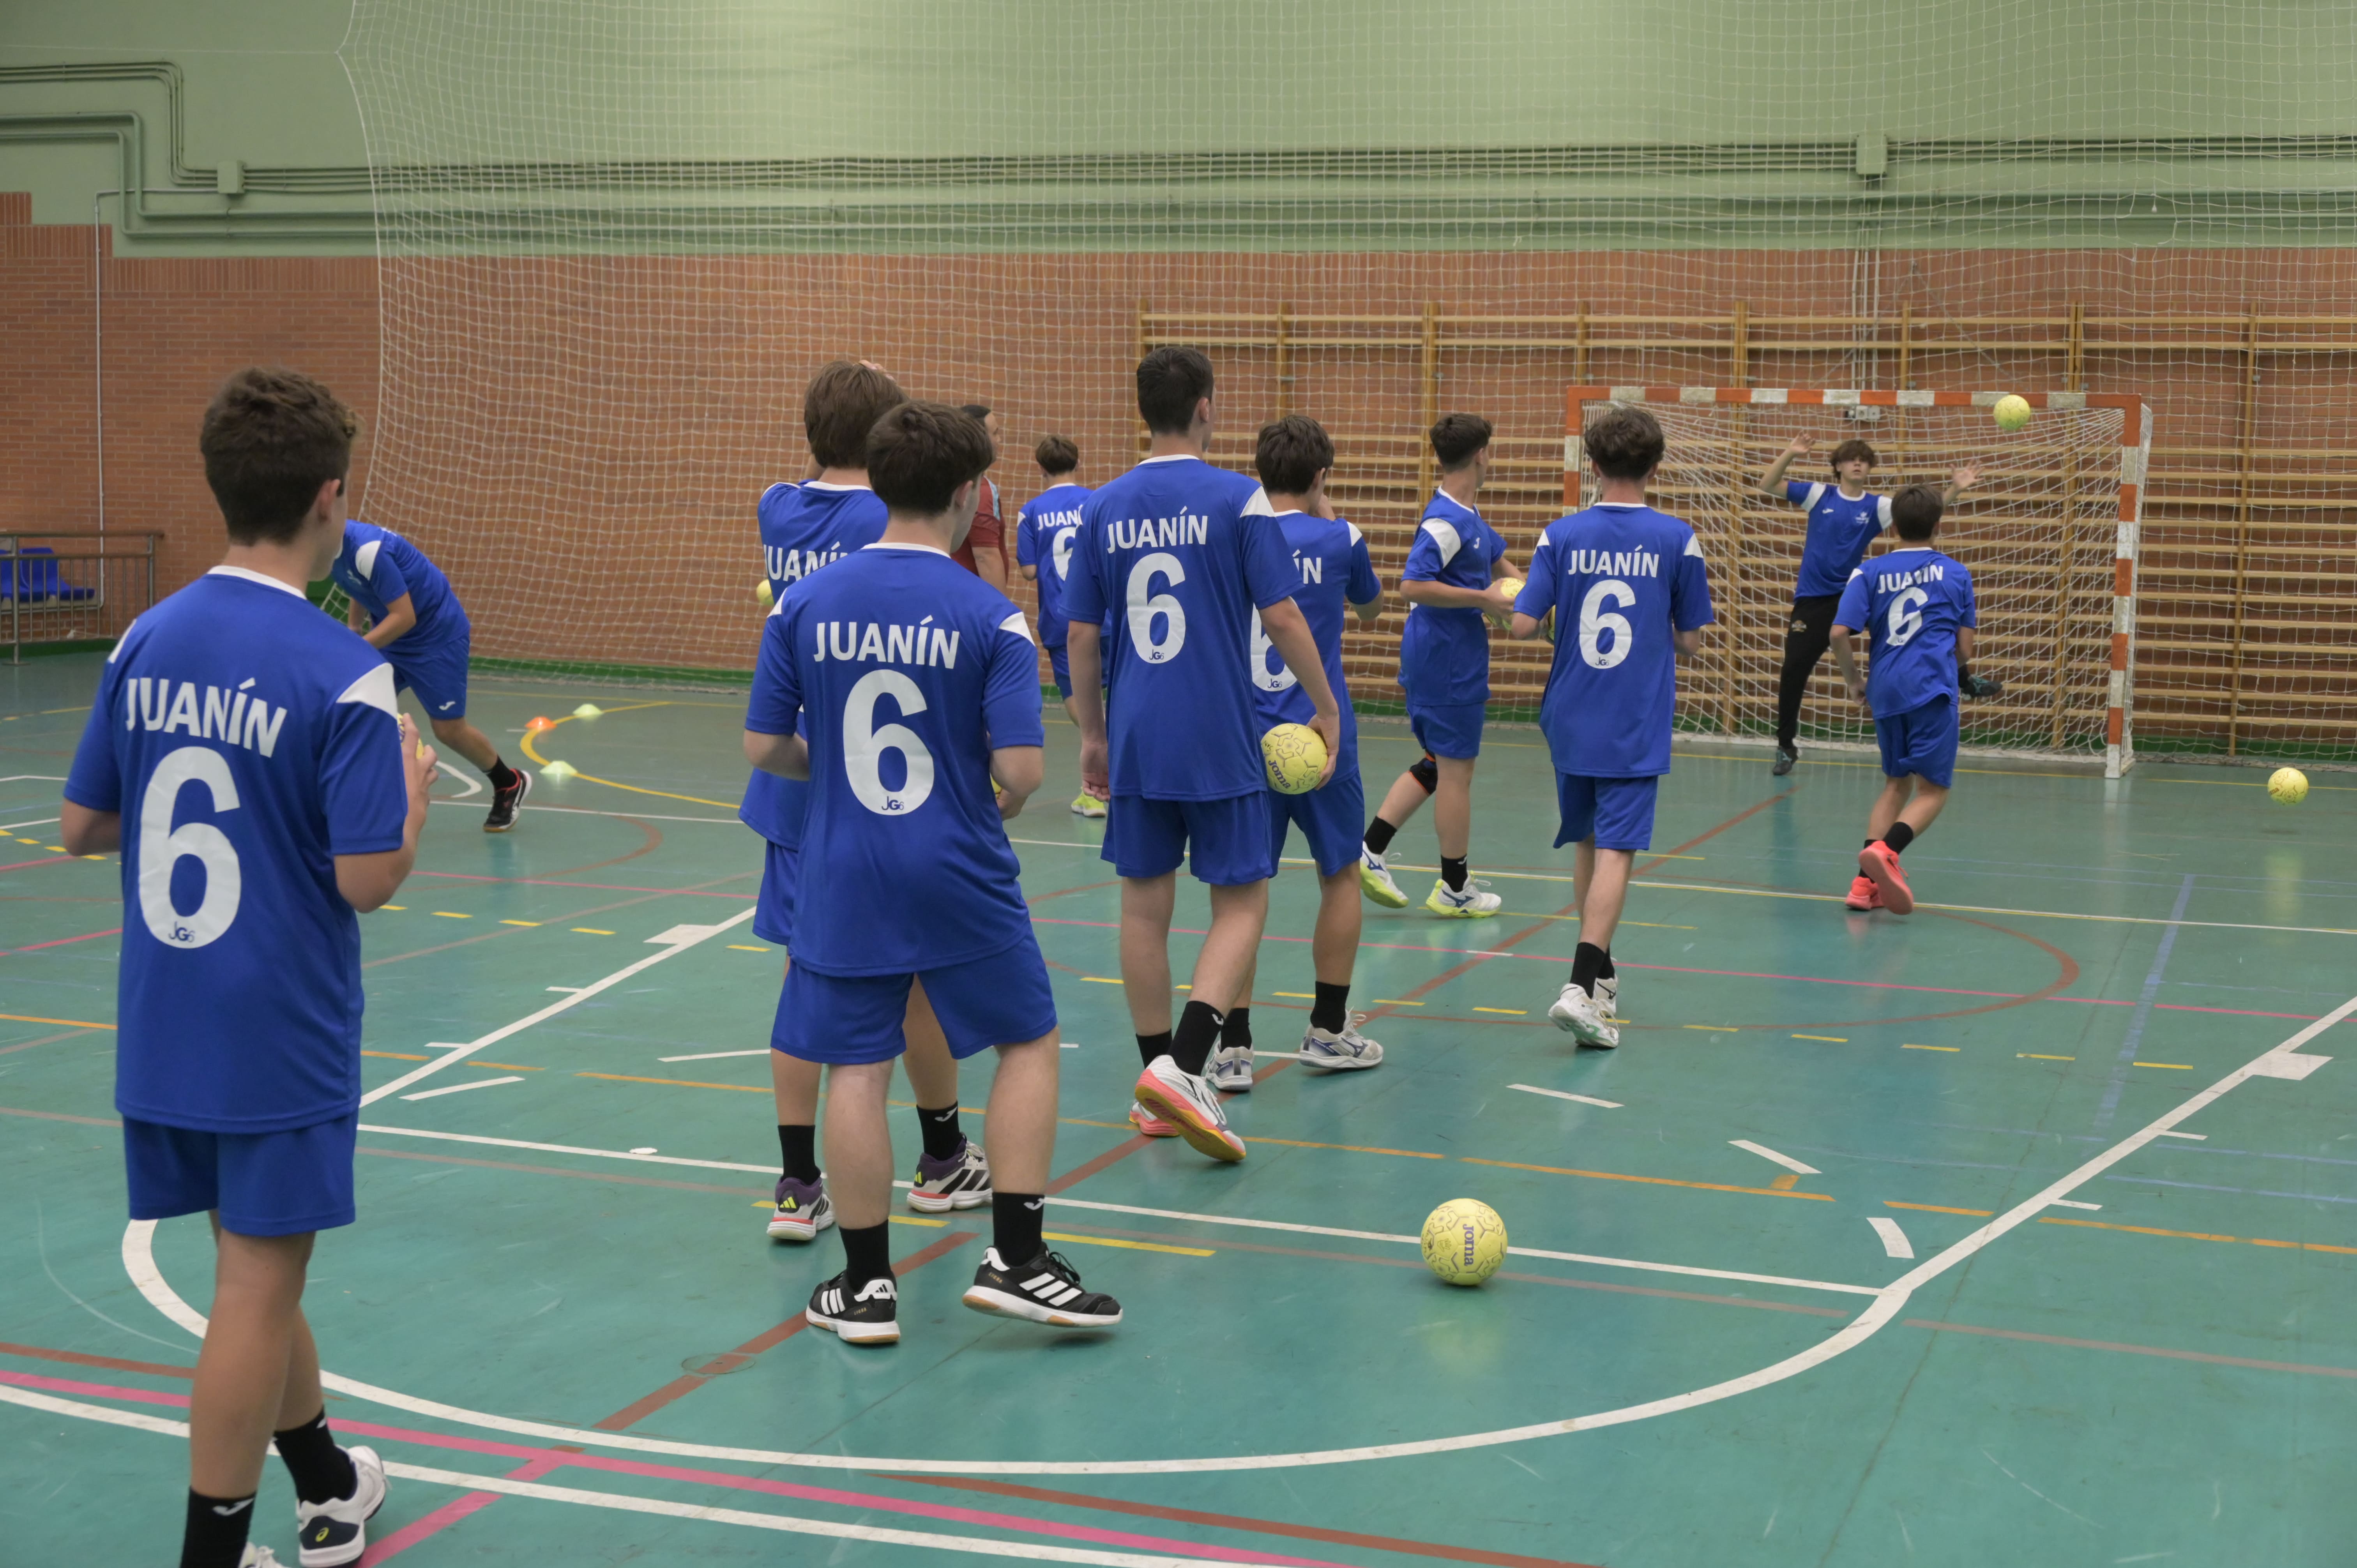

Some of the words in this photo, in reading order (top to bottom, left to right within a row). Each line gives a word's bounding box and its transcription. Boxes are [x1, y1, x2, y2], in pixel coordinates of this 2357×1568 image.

[1107, 506, 1208, 553] JUANÍN
[1568, 544, 1659, 577] JUANÍN
[1126, 553, 1186, 664] 6
[1579, 579, 1636, 669] 6
[1886, 586, 1928, 646] 6
[814, 615, 959, 669] JUANÍN
[1149, 648, 1165, 660] JG6
[126, 677, 287, 758] JUANÍN
[843, 669, 934, 816] 6
[881, 796, 905, 810] JG6
[138, 746, 241, 948] 6
[168, 921, 196, 943] JG6
[1463, 1224, 1474, 1266] Joma
